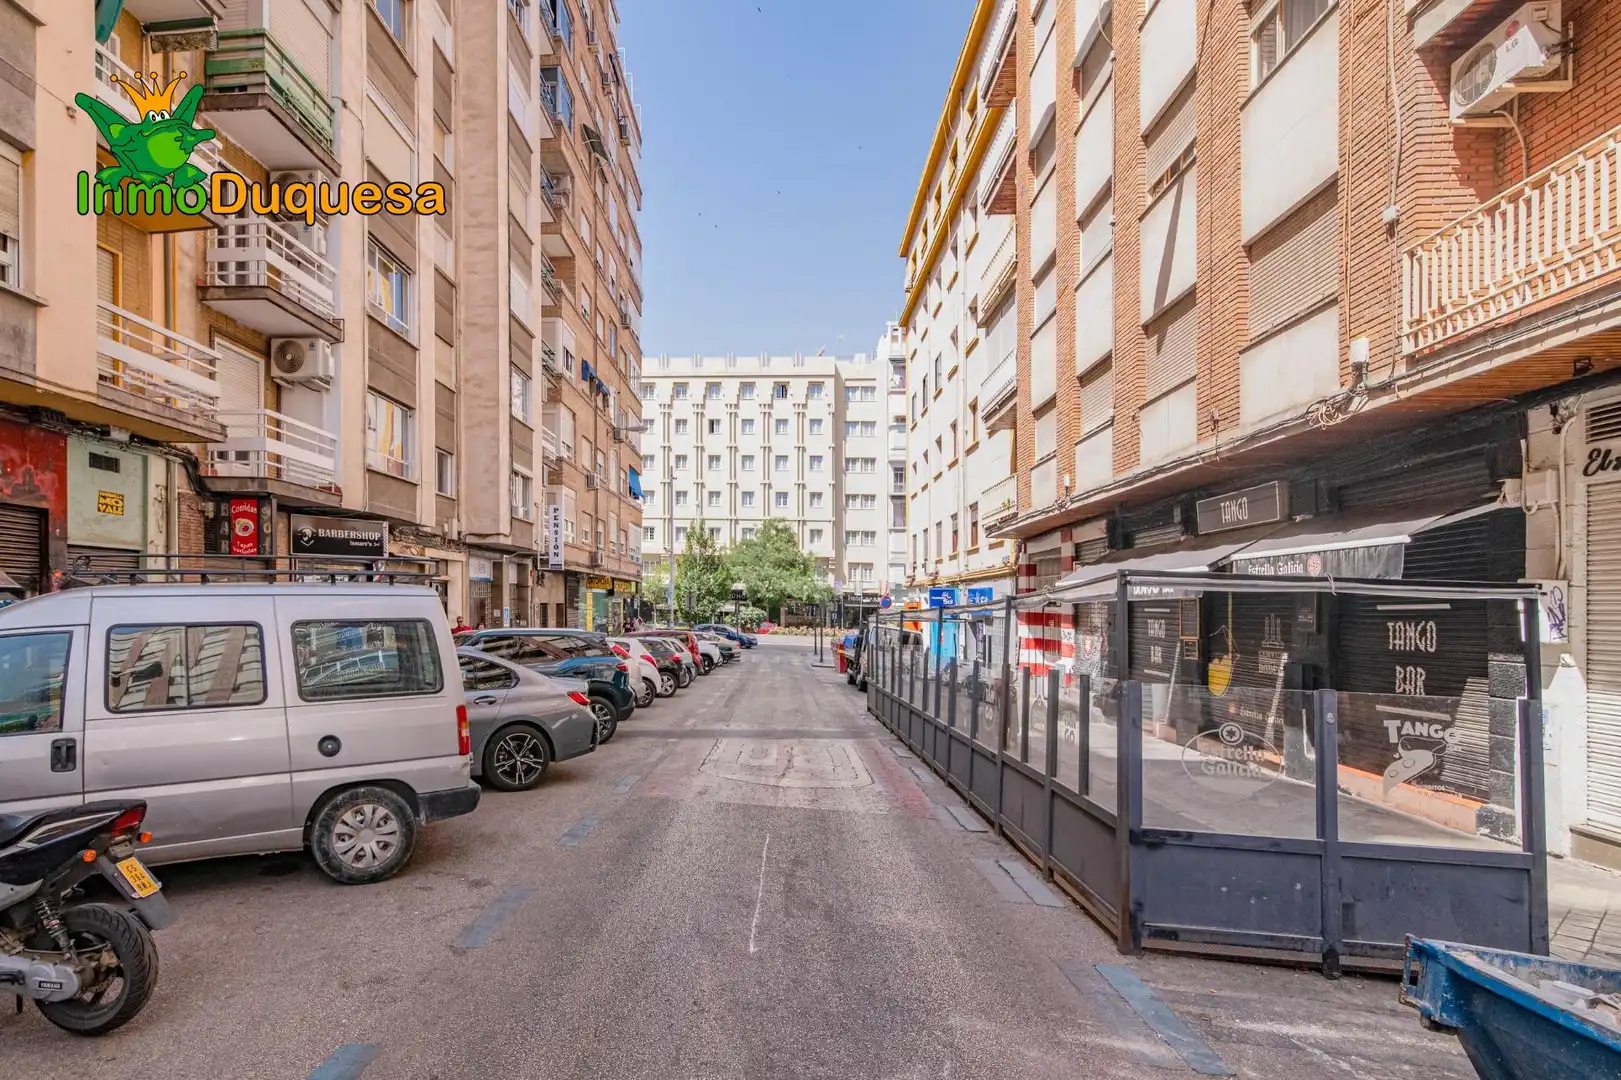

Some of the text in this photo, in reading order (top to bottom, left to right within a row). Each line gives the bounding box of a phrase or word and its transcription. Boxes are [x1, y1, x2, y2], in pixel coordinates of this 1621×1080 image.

[1505, 38, 1519, 53] LG
[231, 502, 258, 514] Comidas
[1219, 496, 1249, 525] TANGO
[318, 528, 381, 541] BARBERSHOP
[1247, 562, 1304, 576] Estrella Galicia
[1386, 620, 1437, 653] TANGO
[1395, 665, 1427, 696] BAR
[1383, 719, 1461, 744] TANGO
